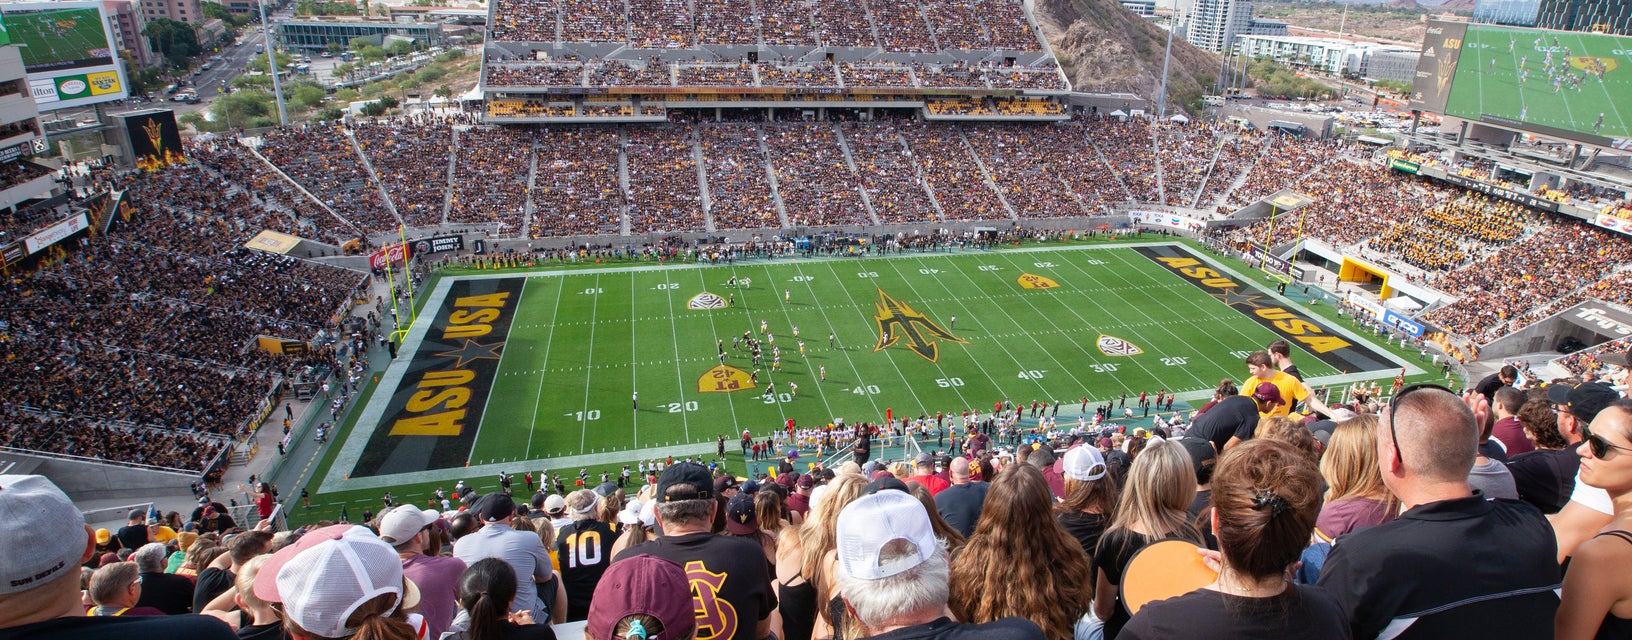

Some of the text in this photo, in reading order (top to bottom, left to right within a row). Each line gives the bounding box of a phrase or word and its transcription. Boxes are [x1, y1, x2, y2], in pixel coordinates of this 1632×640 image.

[1443, 38, 1461, 49] ASU
[33, 86, 55, 96] ilton
[432, 237, 459, 246] JIMMY
[433, 243, 460, 252] JOHNS
[1155, 256, 1352, 354] ASU USA
[1229, 350, 1249, 359] 10
[388, 291, 510, 436] ASU USA
[1160, 356, 1187, 366] 20
[1089, 363, 1117, 373] 30
[712, 369, 735, 379] 42
[1017, 370, 1043, 380] 40
[715, 380, 740, 391] PT
[935, 377, 965, 388] 50
[852, 384, 881, 396] 40
[763, 393, 792, 404] 30
[668, 401, 699, 413] 20
[575, 409, 601, 421] 10
[566, 530, 601, 568] 10
[10, 560, 66, 587] SUN DEVILS
